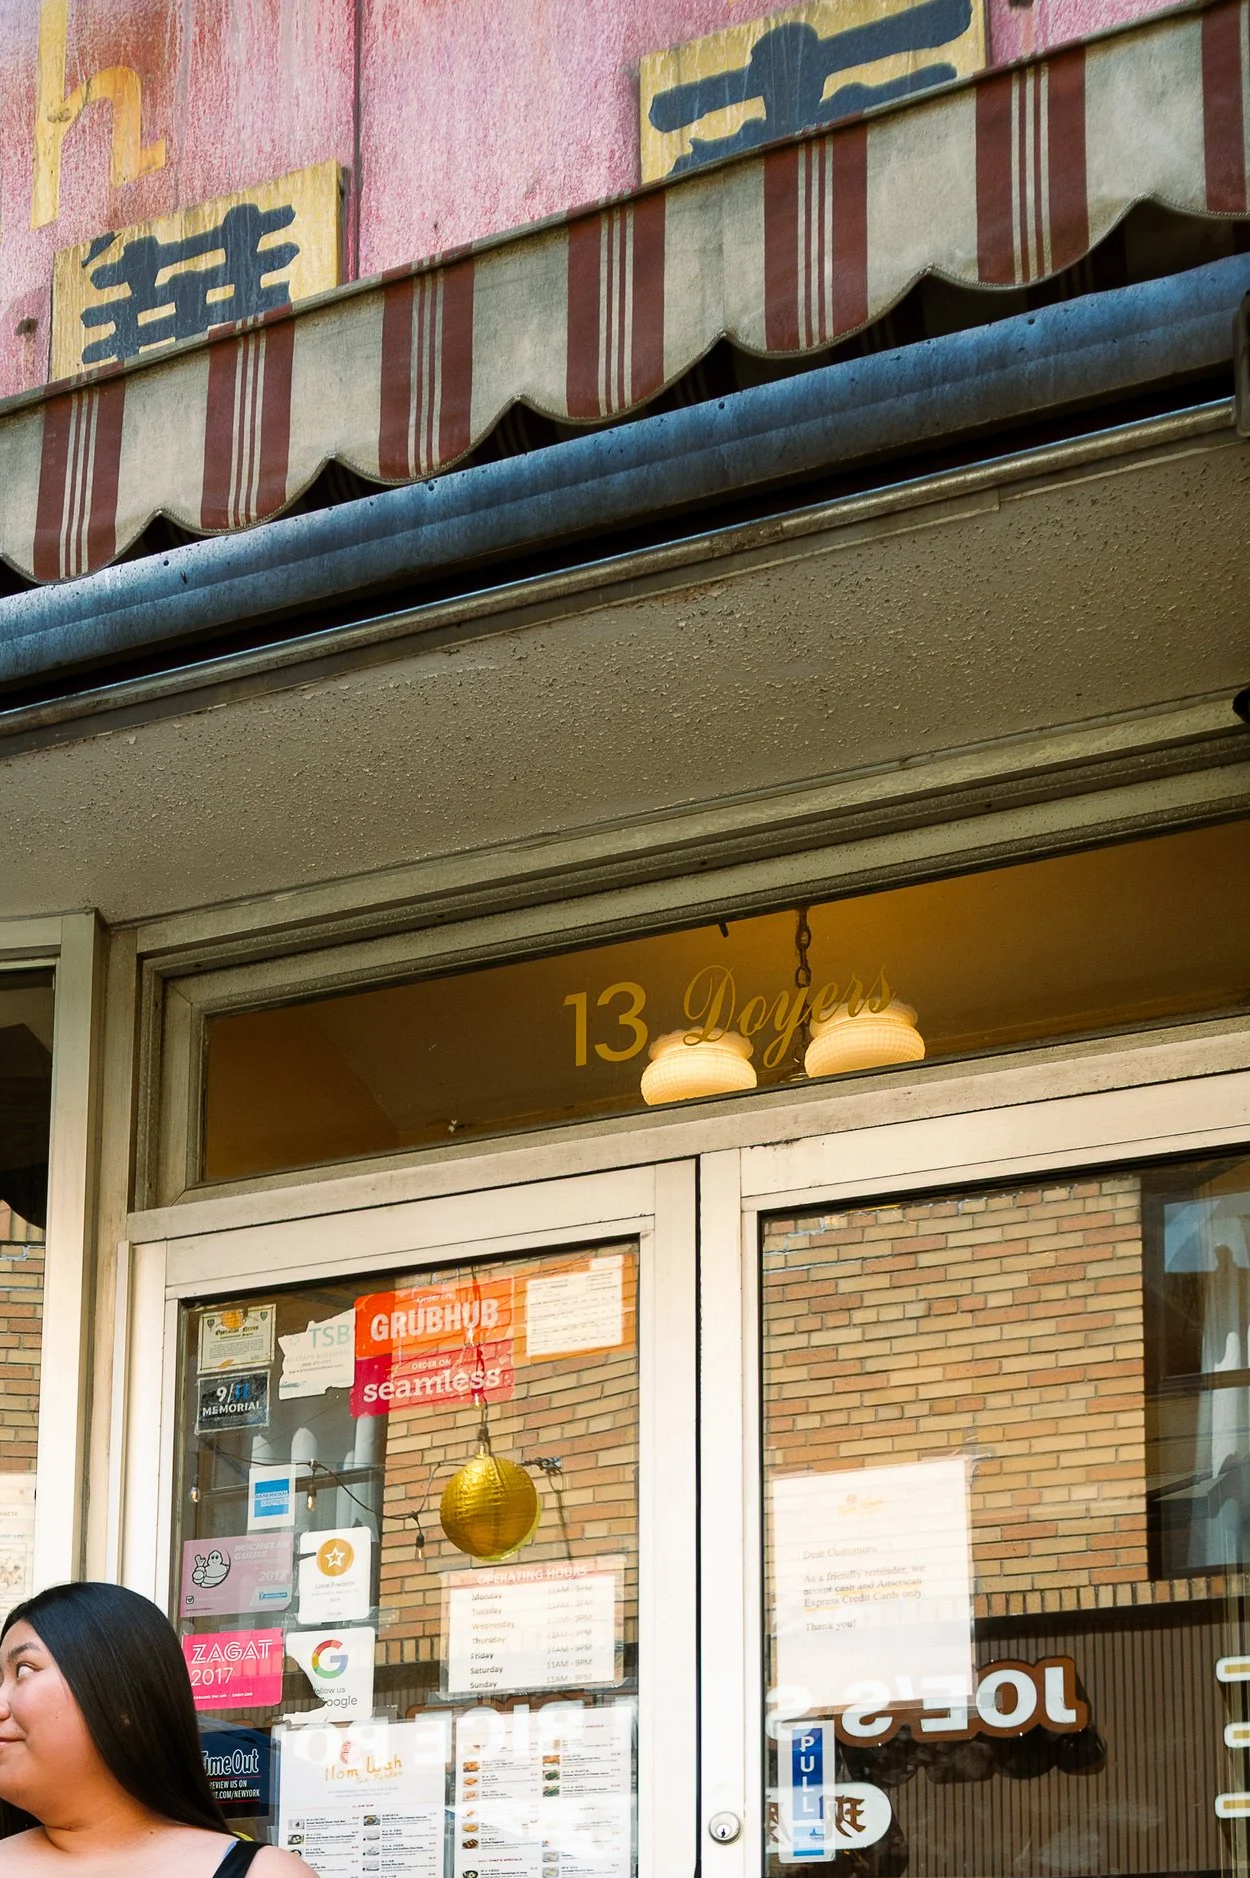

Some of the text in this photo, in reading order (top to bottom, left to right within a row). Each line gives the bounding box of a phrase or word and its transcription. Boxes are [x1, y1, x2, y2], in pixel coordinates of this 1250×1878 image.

[564, 964, 896, 1069] 13 Doyers
[370, 1299, 499, 1341] GRUBHUB
[309, 1325, 350, 1348] TSB
[412, 1359, 450, 1370] ORDER ON
[216, 1380, 249, 1403] 9/11
[363, 1367, 501, 1402] seamless
[202, 1402, 262, 1416] MEMORIAL
[255, 1491, 289, 1499] AMERICAN
[234, 1541, 289, 1552] MICHELIN
[234, 1550, 268, 1560] GUIDE
[803, 1549, 824, 1560] Dear
[477, 1565, 587, 1584] OPERATING HOURS
[804, 1574, 816, 1583] As
[826, 1570, 861, 1581] friendly
[835, 1583, 855, 1592] cash
[858, 1581, 874, 1591] and
[877, 1578, 922, 1588] American
[804, 1597, 839, 1608] Express
[842, 1593, 870, 1603] Credit
[873, 1590, 900, 1600] Cards
[806, 1619, 856, 1631] Thank you!
[191, 1639, 273, 1664] ZAGAT
[471, 1652, 494, 1660] Friday
[191, 1667, 234, 1686] 2017
[470, 1666, 503, 1674] Saturday
[470, 1681, 497, 1689] Sunday
[326, 1695, 357, 1708] oogle
[231, 1749, 259, 1774] Out
[366, 1754, 402, 1773] Wah
[800, 1735, 815, 1813] PULL
[230, 1780, 238, 1788] US
[239, 1779, 247, 1787] ON
[214, 1789, 260, 1800] T.COM/NEWYORK
